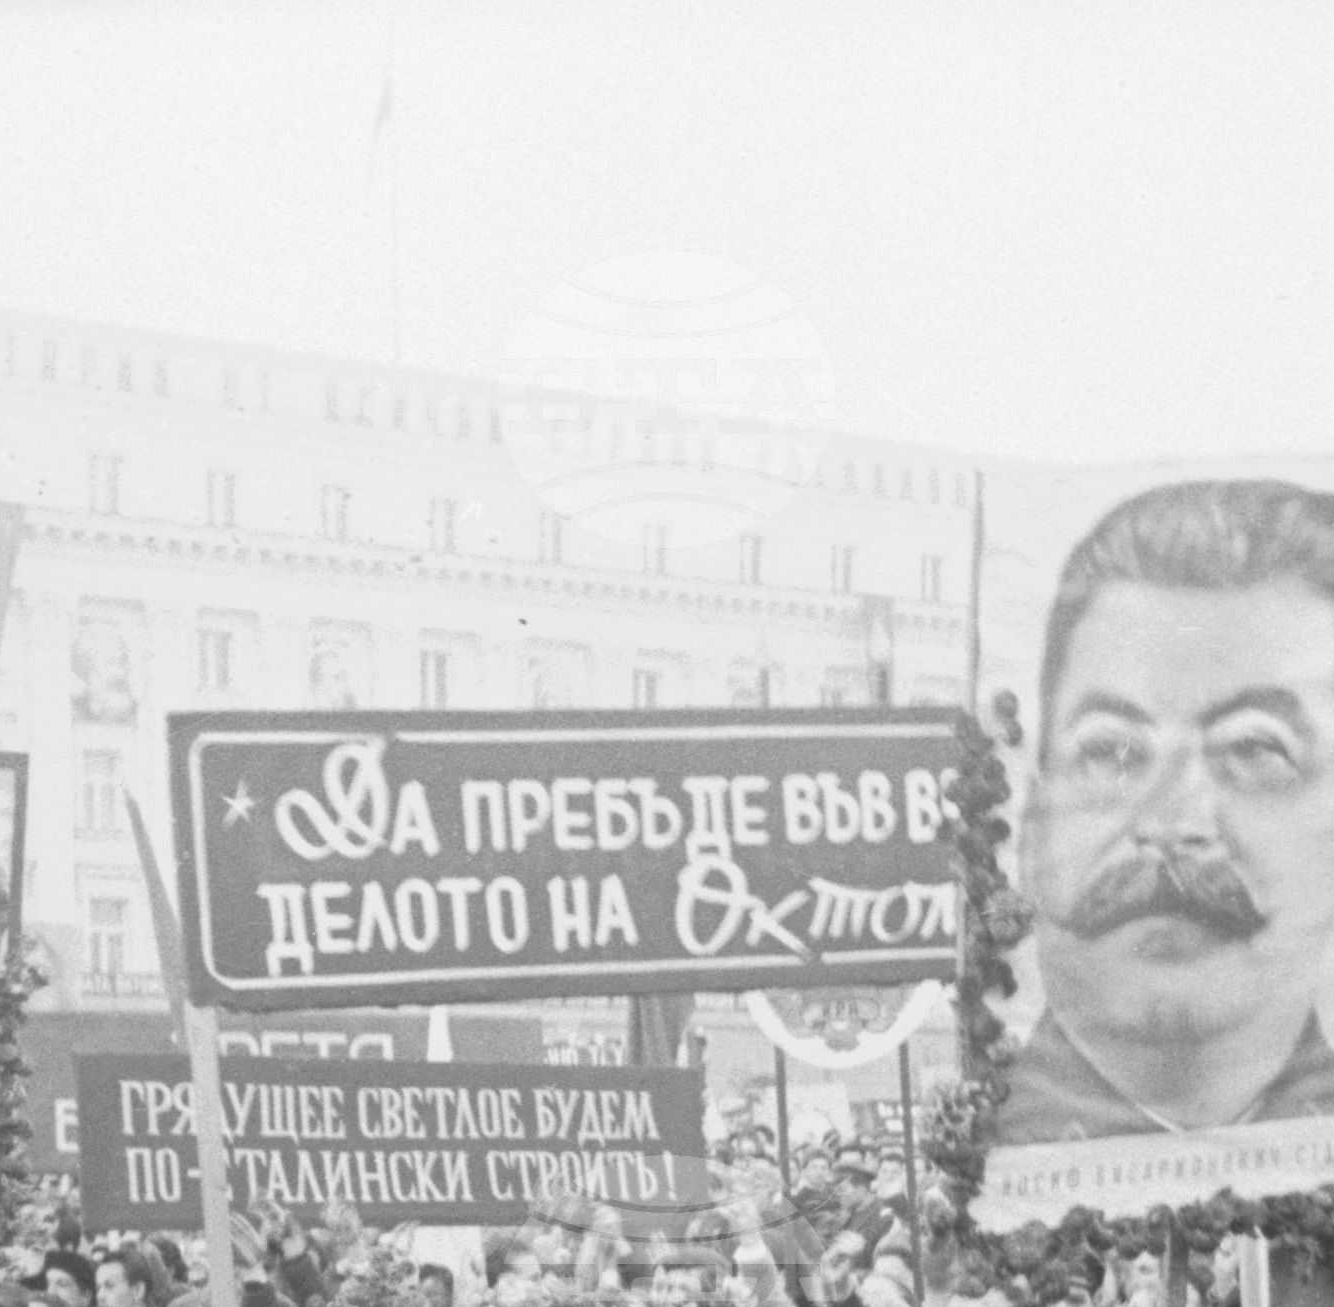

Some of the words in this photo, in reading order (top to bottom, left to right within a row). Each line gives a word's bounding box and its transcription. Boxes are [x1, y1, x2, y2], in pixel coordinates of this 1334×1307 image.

[461, 775, 770, 862] ПРЕБЪДЕ
[782, 769, 897, 845] ВЪВ
[256, 876, 529, 976] ДЕЛОТО
[547, 873, 638, 953] НА
[120, 1080, 346, 1144] ГРЯУЩЕЕ
[357, 1087, 525, 1139] СВЕТЛОЕ
[533, 1085, 660, 1147] БУДЕМ
[125, 1147, 473, 1203] ПО-ТАЛИНСКИ
[486, 1151, 677, 1201] СТРОИТЬ!
